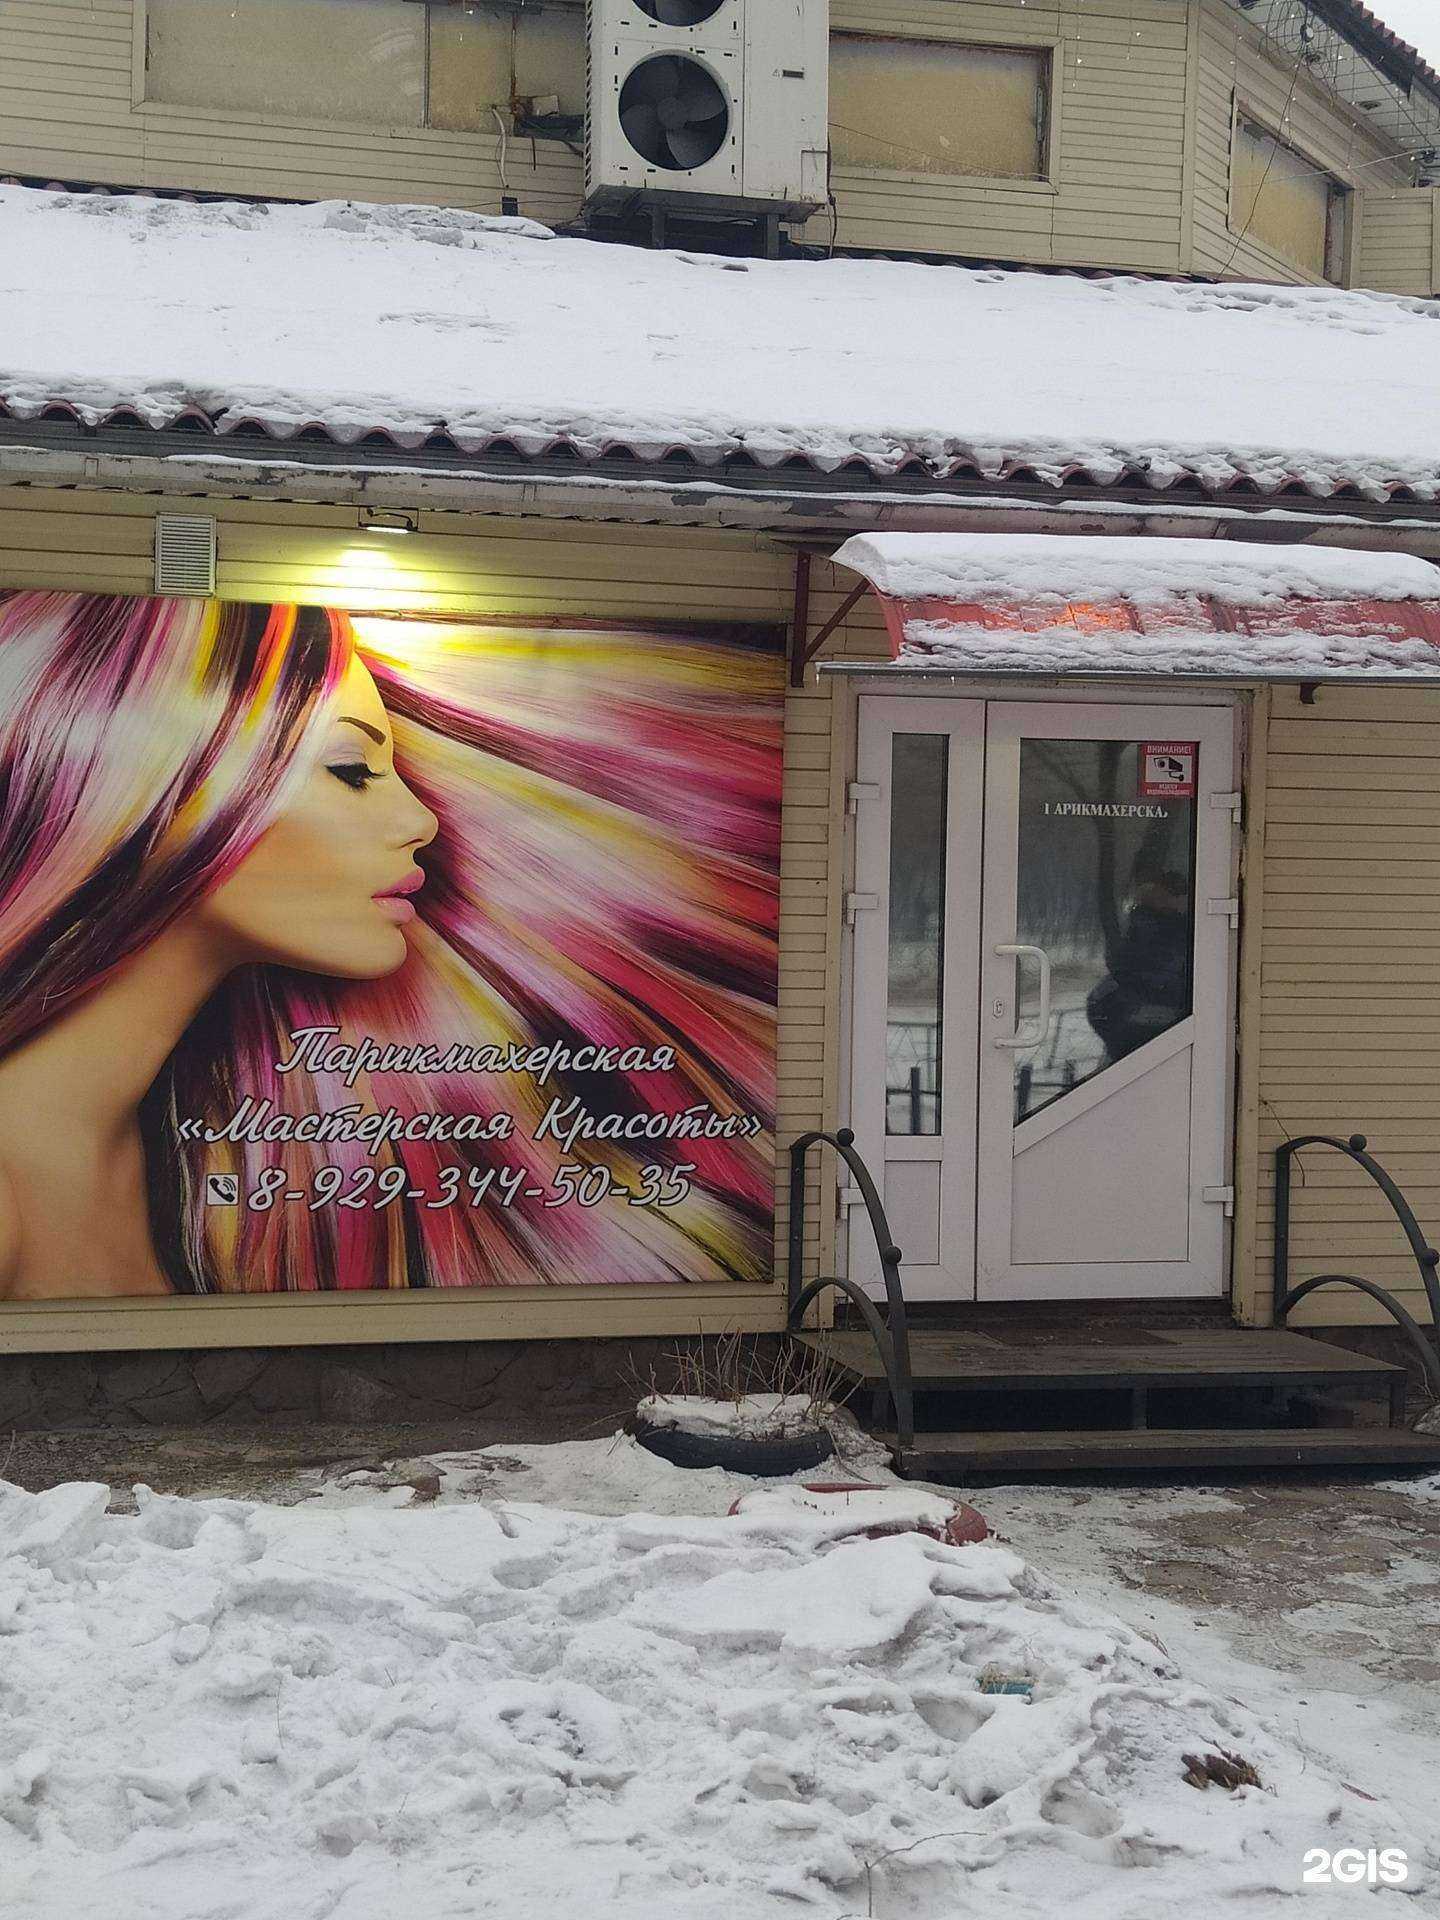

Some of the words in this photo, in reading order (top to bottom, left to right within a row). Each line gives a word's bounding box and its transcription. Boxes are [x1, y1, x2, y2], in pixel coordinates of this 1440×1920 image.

[275, 1026, 675, 1088] Парикмахерская
[178, 1096, 512, 1155] «Мастерская
[534, 1096, 762, 1156] Красоты»
[248, 1164, 697, 1211] 8-929-344-50-35
